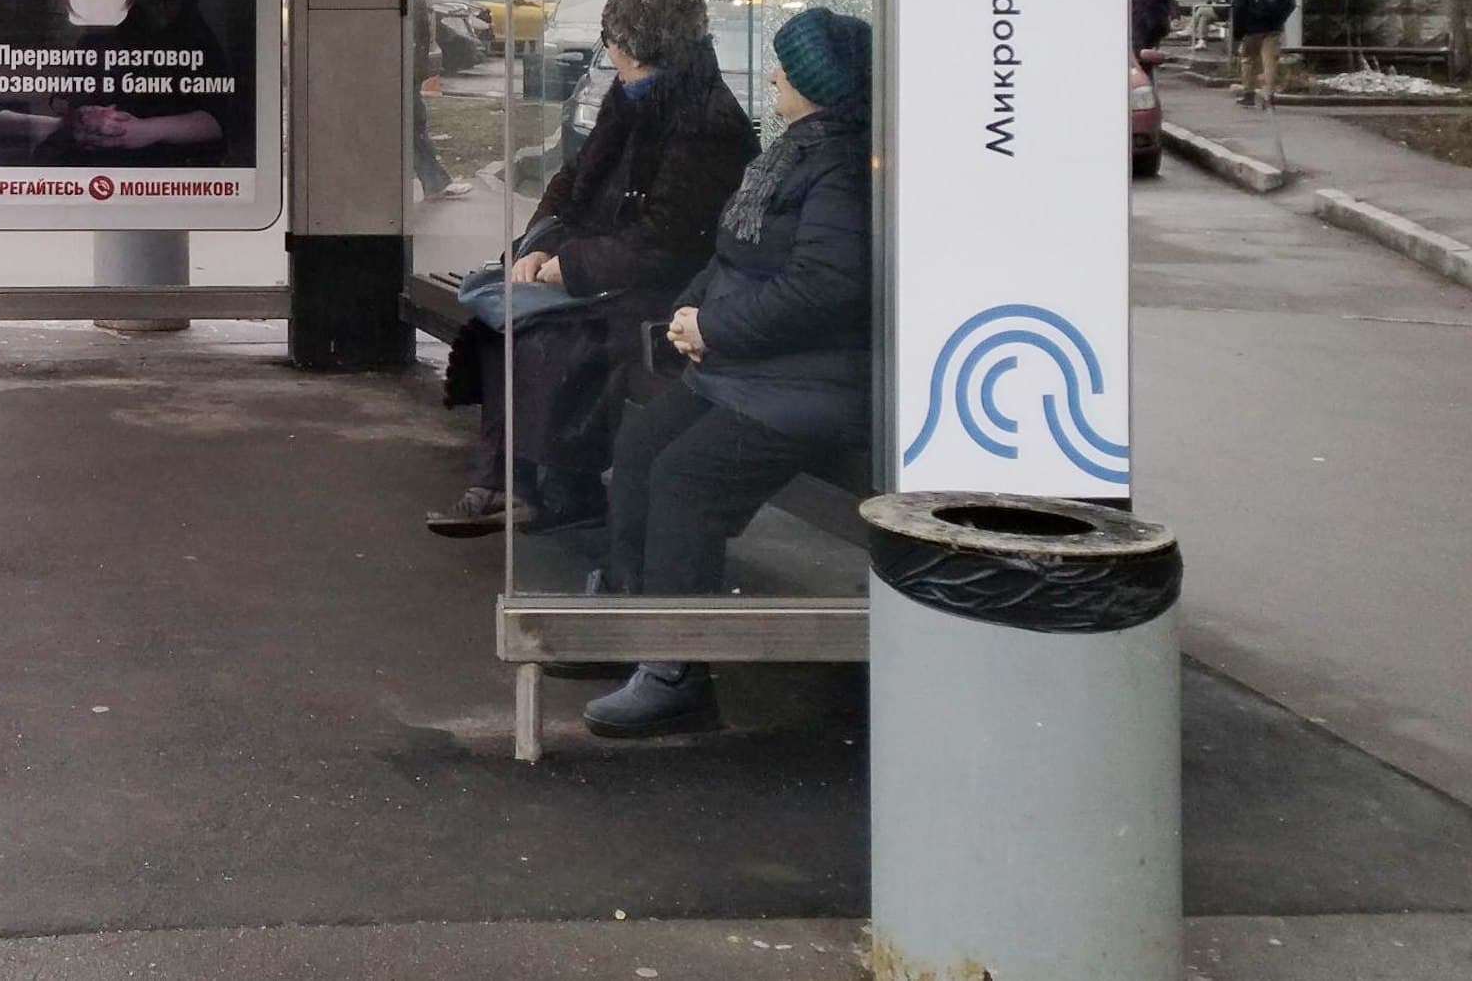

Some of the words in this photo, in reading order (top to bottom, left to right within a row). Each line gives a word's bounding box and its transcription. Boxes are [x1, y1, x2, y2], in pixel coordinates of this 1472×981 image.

[104, 49, 205, 71] разговор
[103, 77, 116, 93] в
[121, 72, 174, 93] банк
[179, 76, 236, 93] сами
[120, 180, 240, 197] МОШЕННИКОВ!
